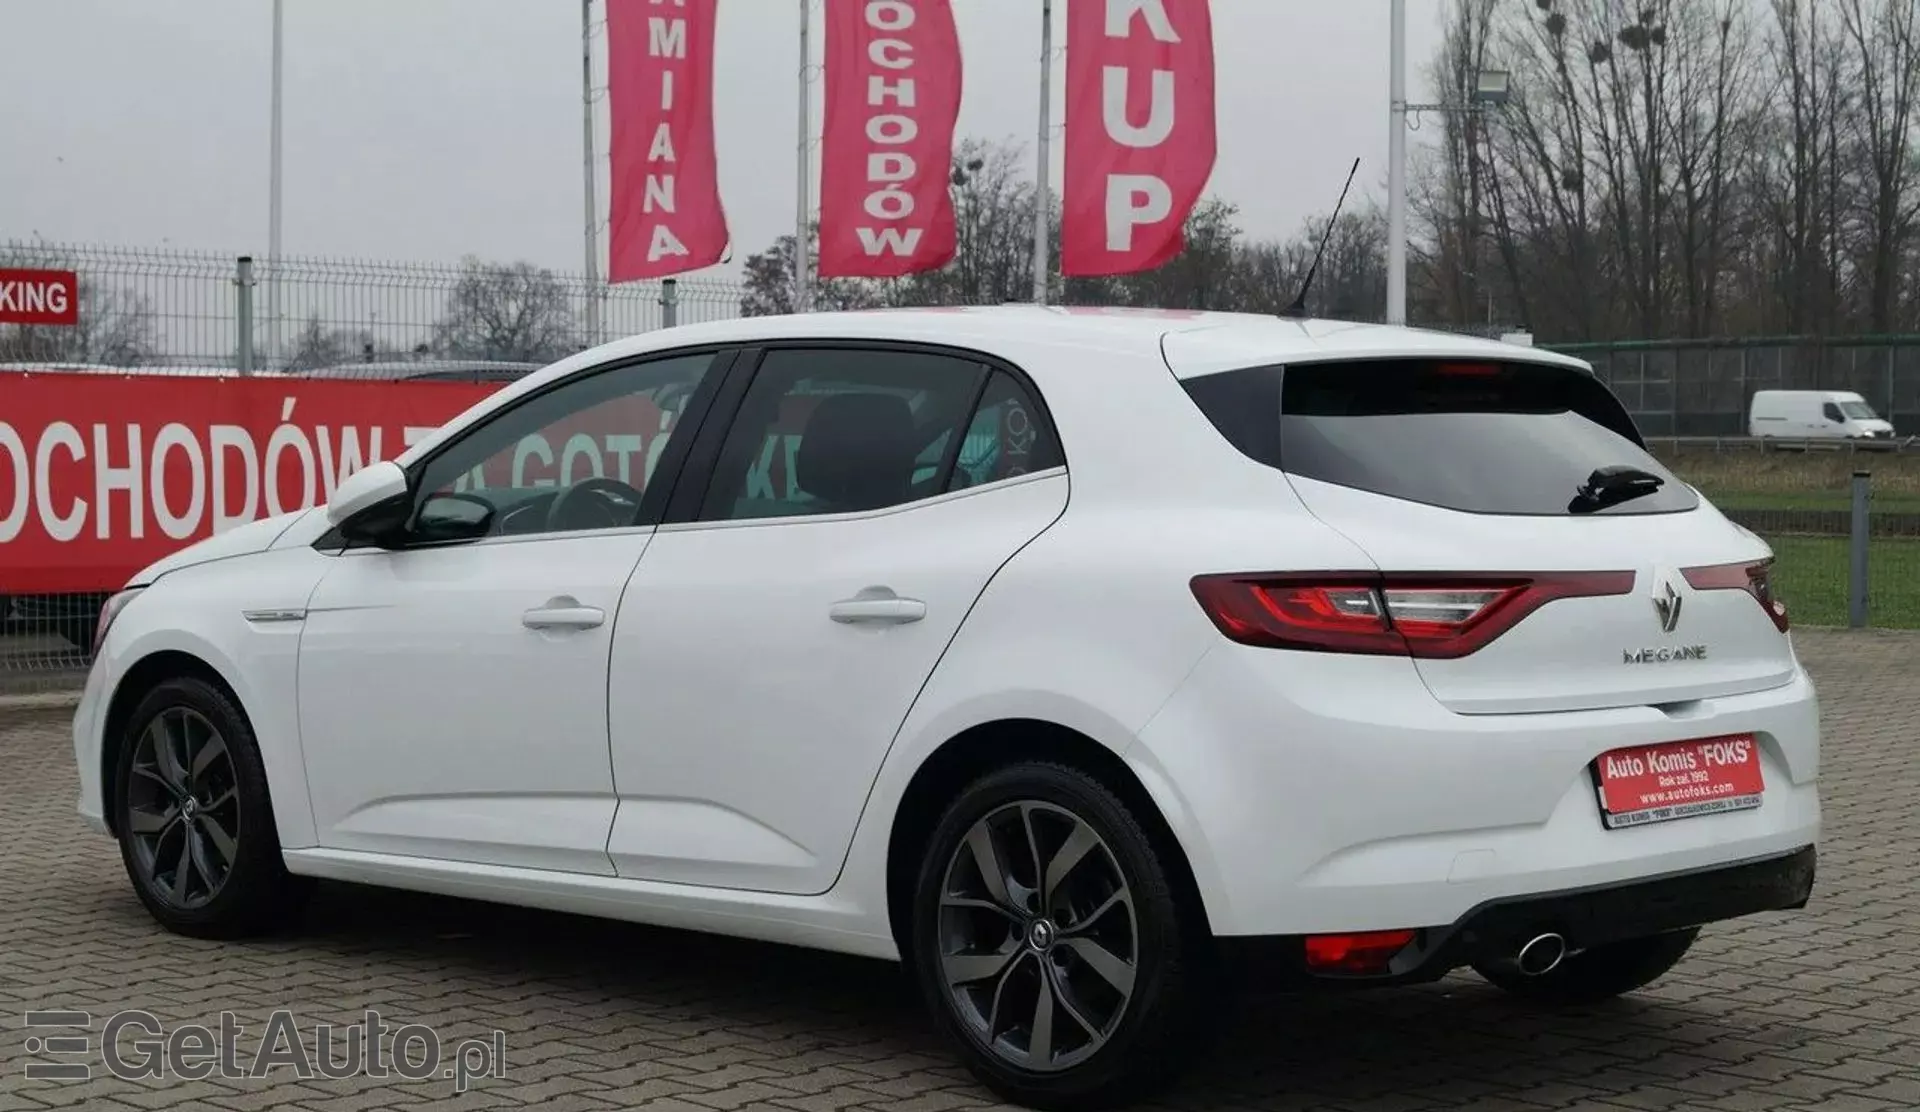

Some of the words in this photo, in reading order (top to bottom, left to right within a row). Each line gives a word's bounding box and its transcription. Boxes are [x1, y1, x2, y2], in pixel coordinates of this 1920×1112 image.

[643, 0, 689, 262] MIANA
[856, 0, 924, 257] OCHODÓW
[0, 280, 68, 314] KING
[1622, 645, 1708, 664] MEGANE
[1607, 755, 1644, 779] Auto
[1648, 747, 1696, 774] Komis
[1699, 740, 1752, 767] "FOKS"
[1640, 782, 1734, 804] www.autofoks.com
